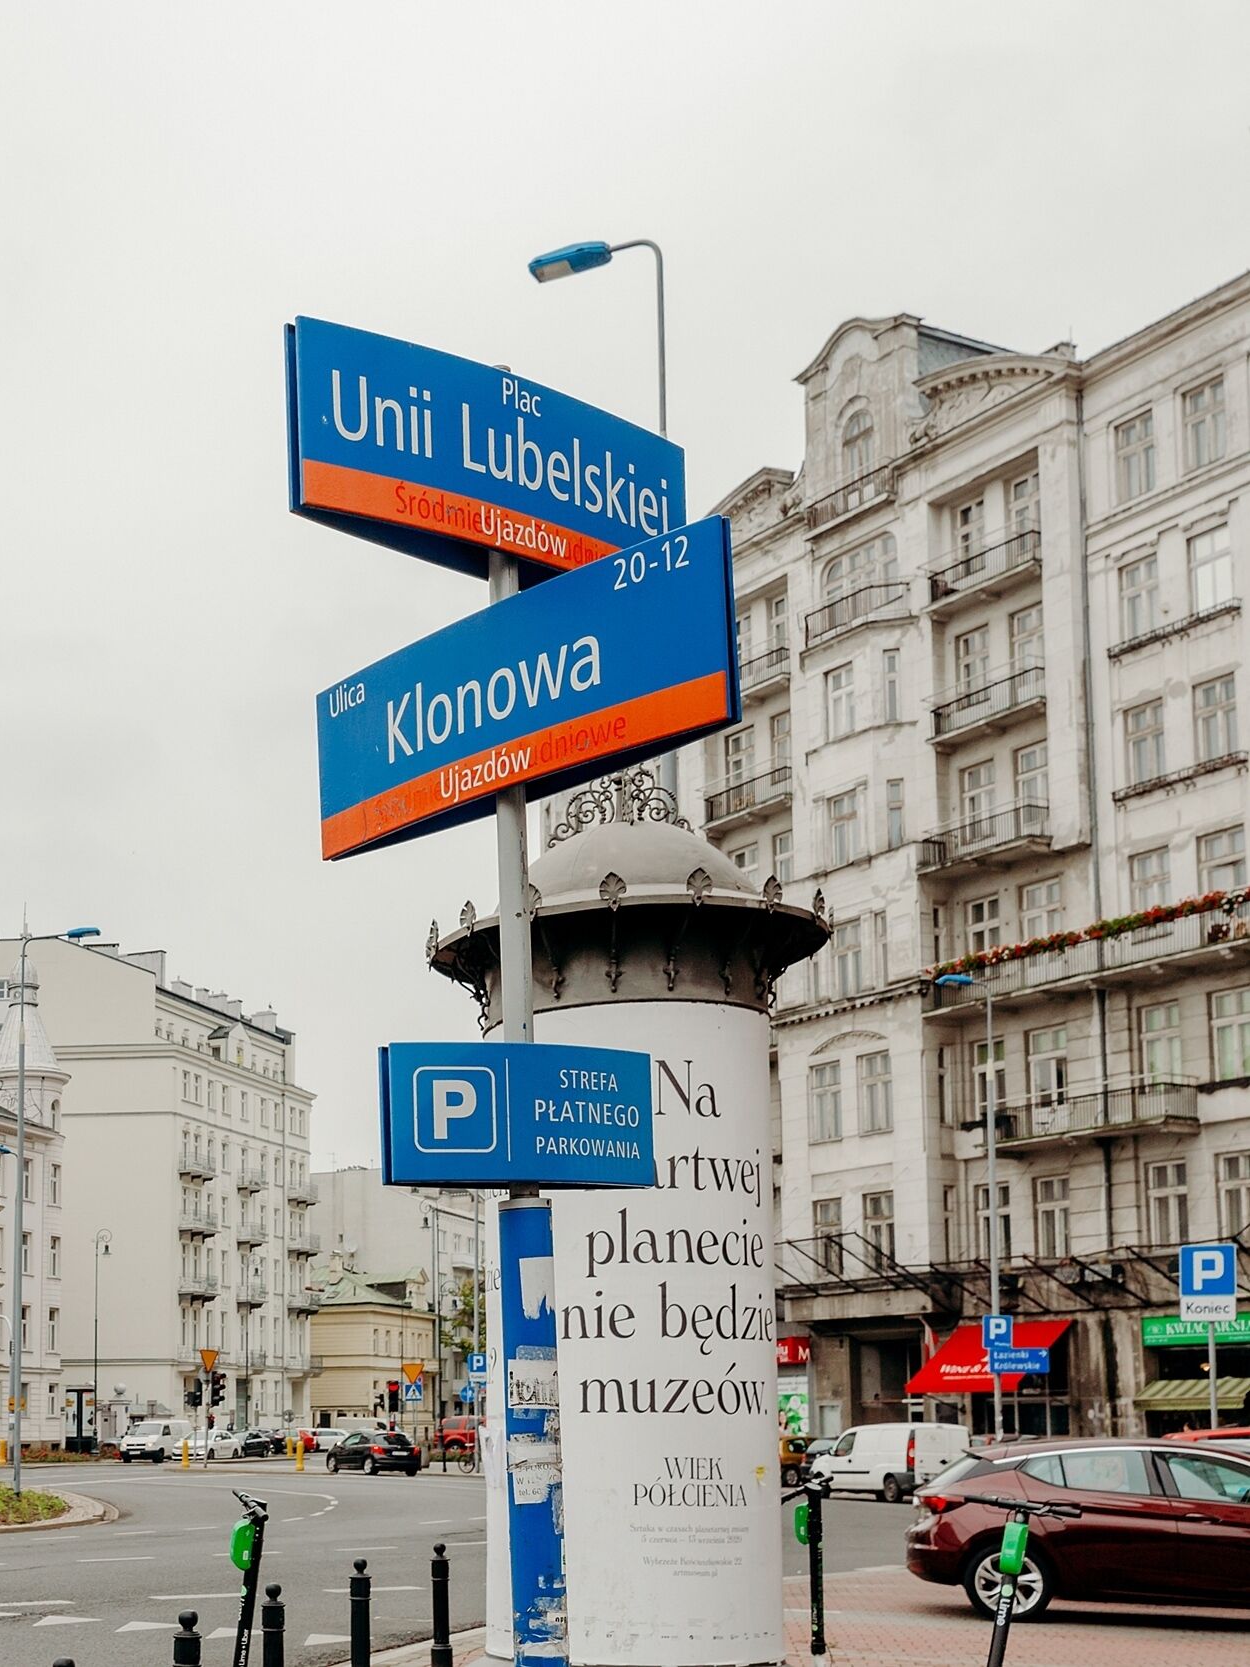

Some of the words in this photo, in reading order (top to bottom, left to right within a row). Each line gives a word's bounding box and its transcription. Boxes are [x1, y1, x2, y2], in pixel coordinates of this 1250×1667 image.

[502, 377, 542, 417] Plac
[332, 369, 432, 458] Unii
[461, 402, 668, 537] Lubelskiej
[480, 505, 567, 558] Ujazdów
[613, 535, 690, 591] 20-12
[329, 680, 366, 718] Ulica
[387, 635, 602, 764] Klonowa
[440, 747, 533, 802] Ujazdów
[560, 1069, 618, 1092] STREFA
[654, 1059, 722, 1118] Na
[432, 1079, 477, 1140] P
[534, 1099, 640, 1128] PŁATNEGO
[536, 1136, 640, 1160] PARKOWANIA
[585, 1208, 764, 1278] planecie
[1193, 1251, 1225, 1291] P
[561, 1290, 636, 1340] nie
[658, 1281, 774, 1355] będzie
[989, 1318, 1007, 1339] P
[1186, 1302, 1230, 1315] Koniec
[473, 1355, 484, 1370] P
[579, 1363, 768, 1415] muzeów.
[663, 1456, 723, 1480] WIEK
[632, 1476, 748, 1507] PÓŁCIENIA
[996, 1598, 1011, 1627] Lime
